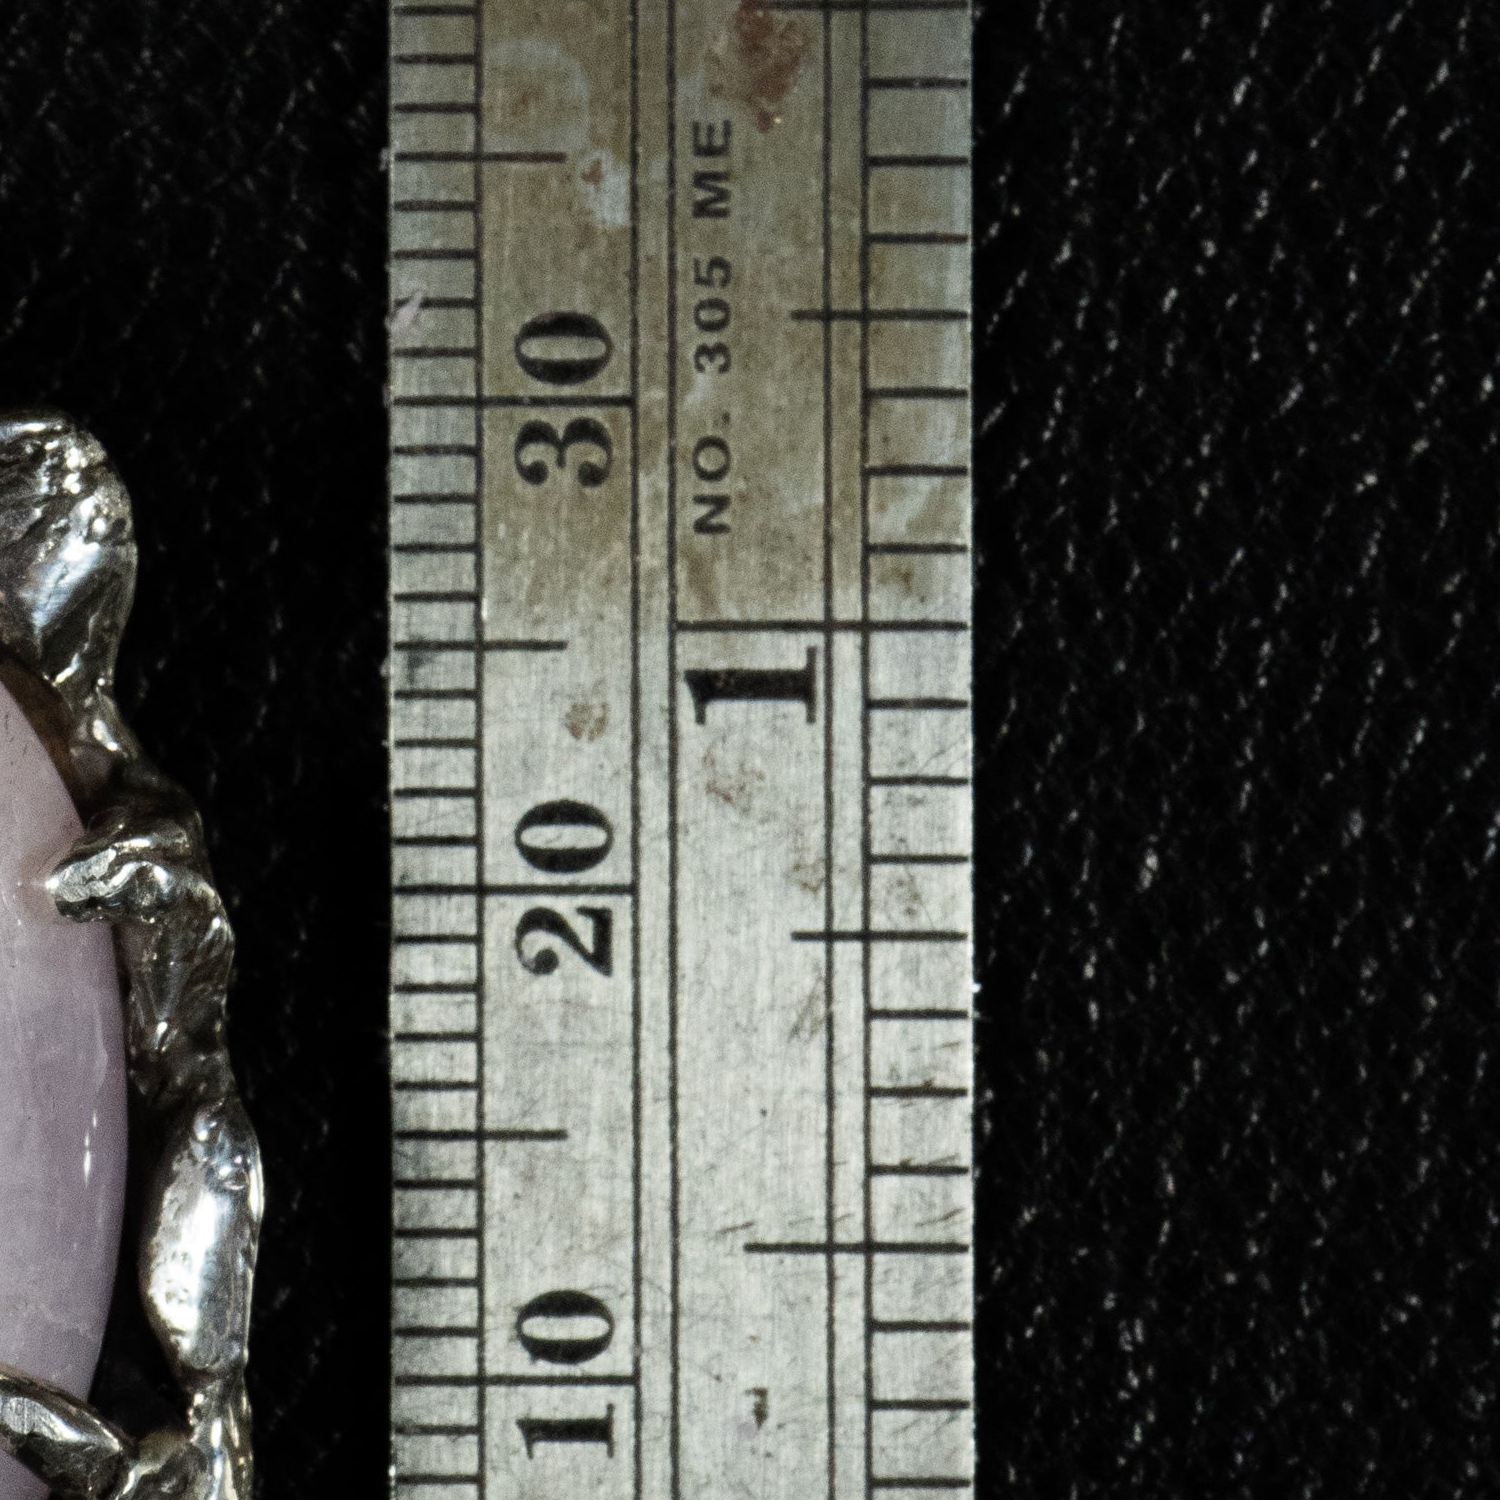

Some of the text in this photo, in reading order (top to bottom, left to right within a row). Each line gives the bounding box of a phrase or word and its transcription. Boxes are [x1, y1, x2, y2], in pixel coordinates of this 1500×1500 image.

[513, 310, 613, 488] 30
[692, 118, 733, 536] NO. 305 ME
[683, 645, 817, 725] 1
[514, 799, 614, 978] 20
[515, 1290, 615, 1460] 10
